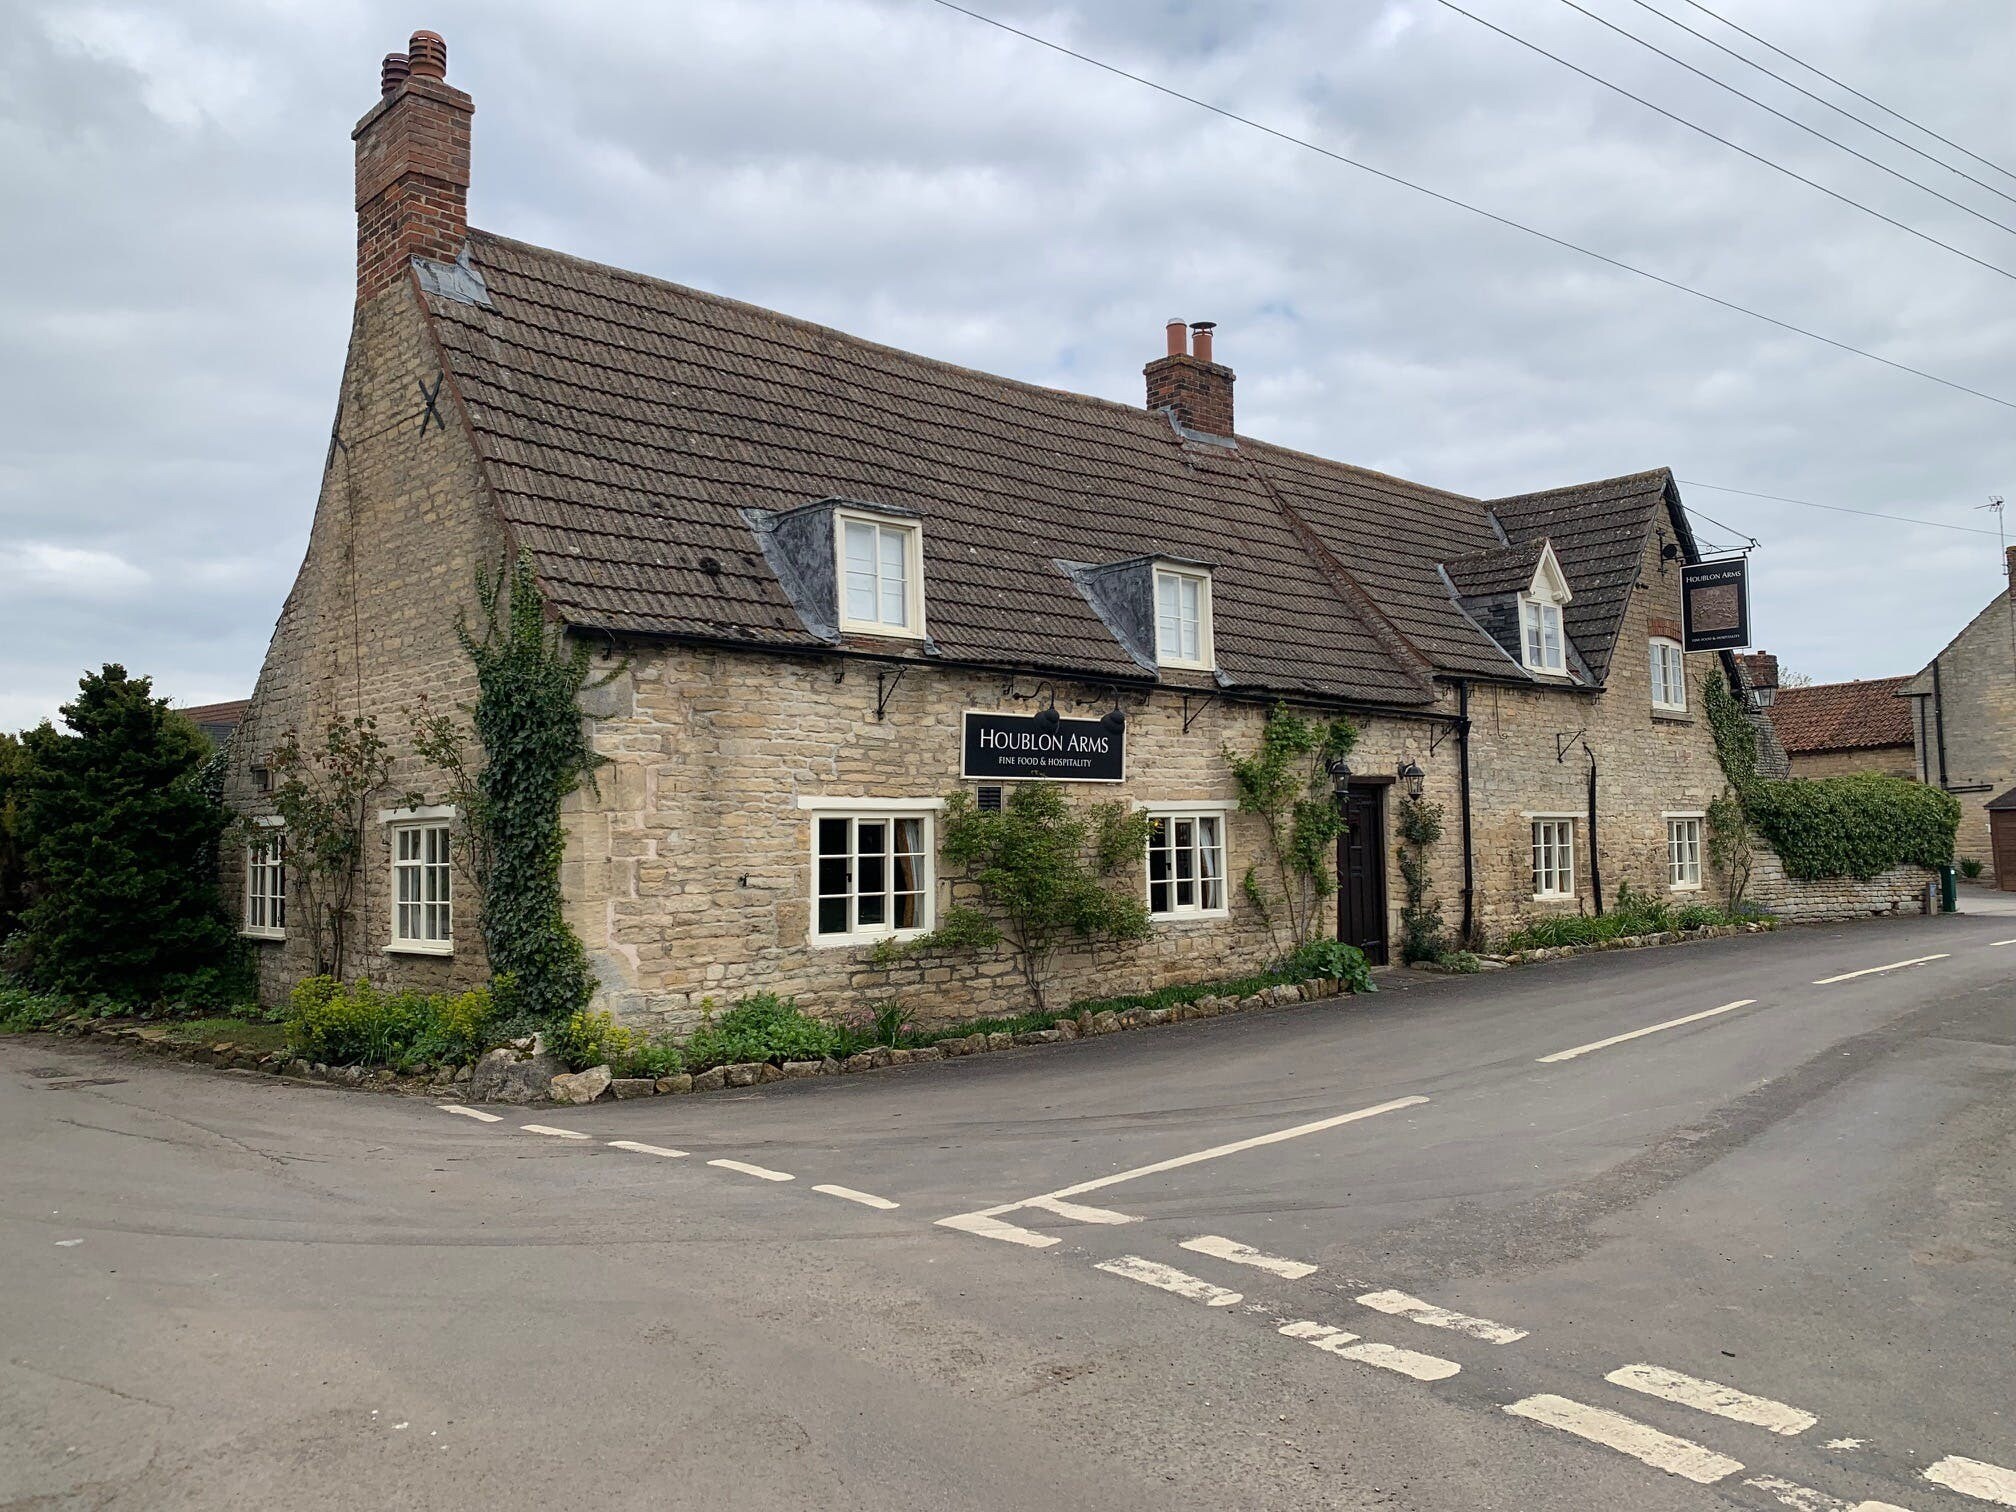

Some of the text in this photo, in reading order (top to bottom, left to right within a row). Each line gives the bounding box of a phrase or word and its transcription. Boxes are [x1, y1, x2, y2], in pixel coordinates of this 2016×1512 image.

[1686, 573, 1720, 583] HOUBLON
[980, 728, 1109, 754] HOUBLON ARMS
[998, 756, 1092, 768] FINE FOOD & HOSPITALITY
